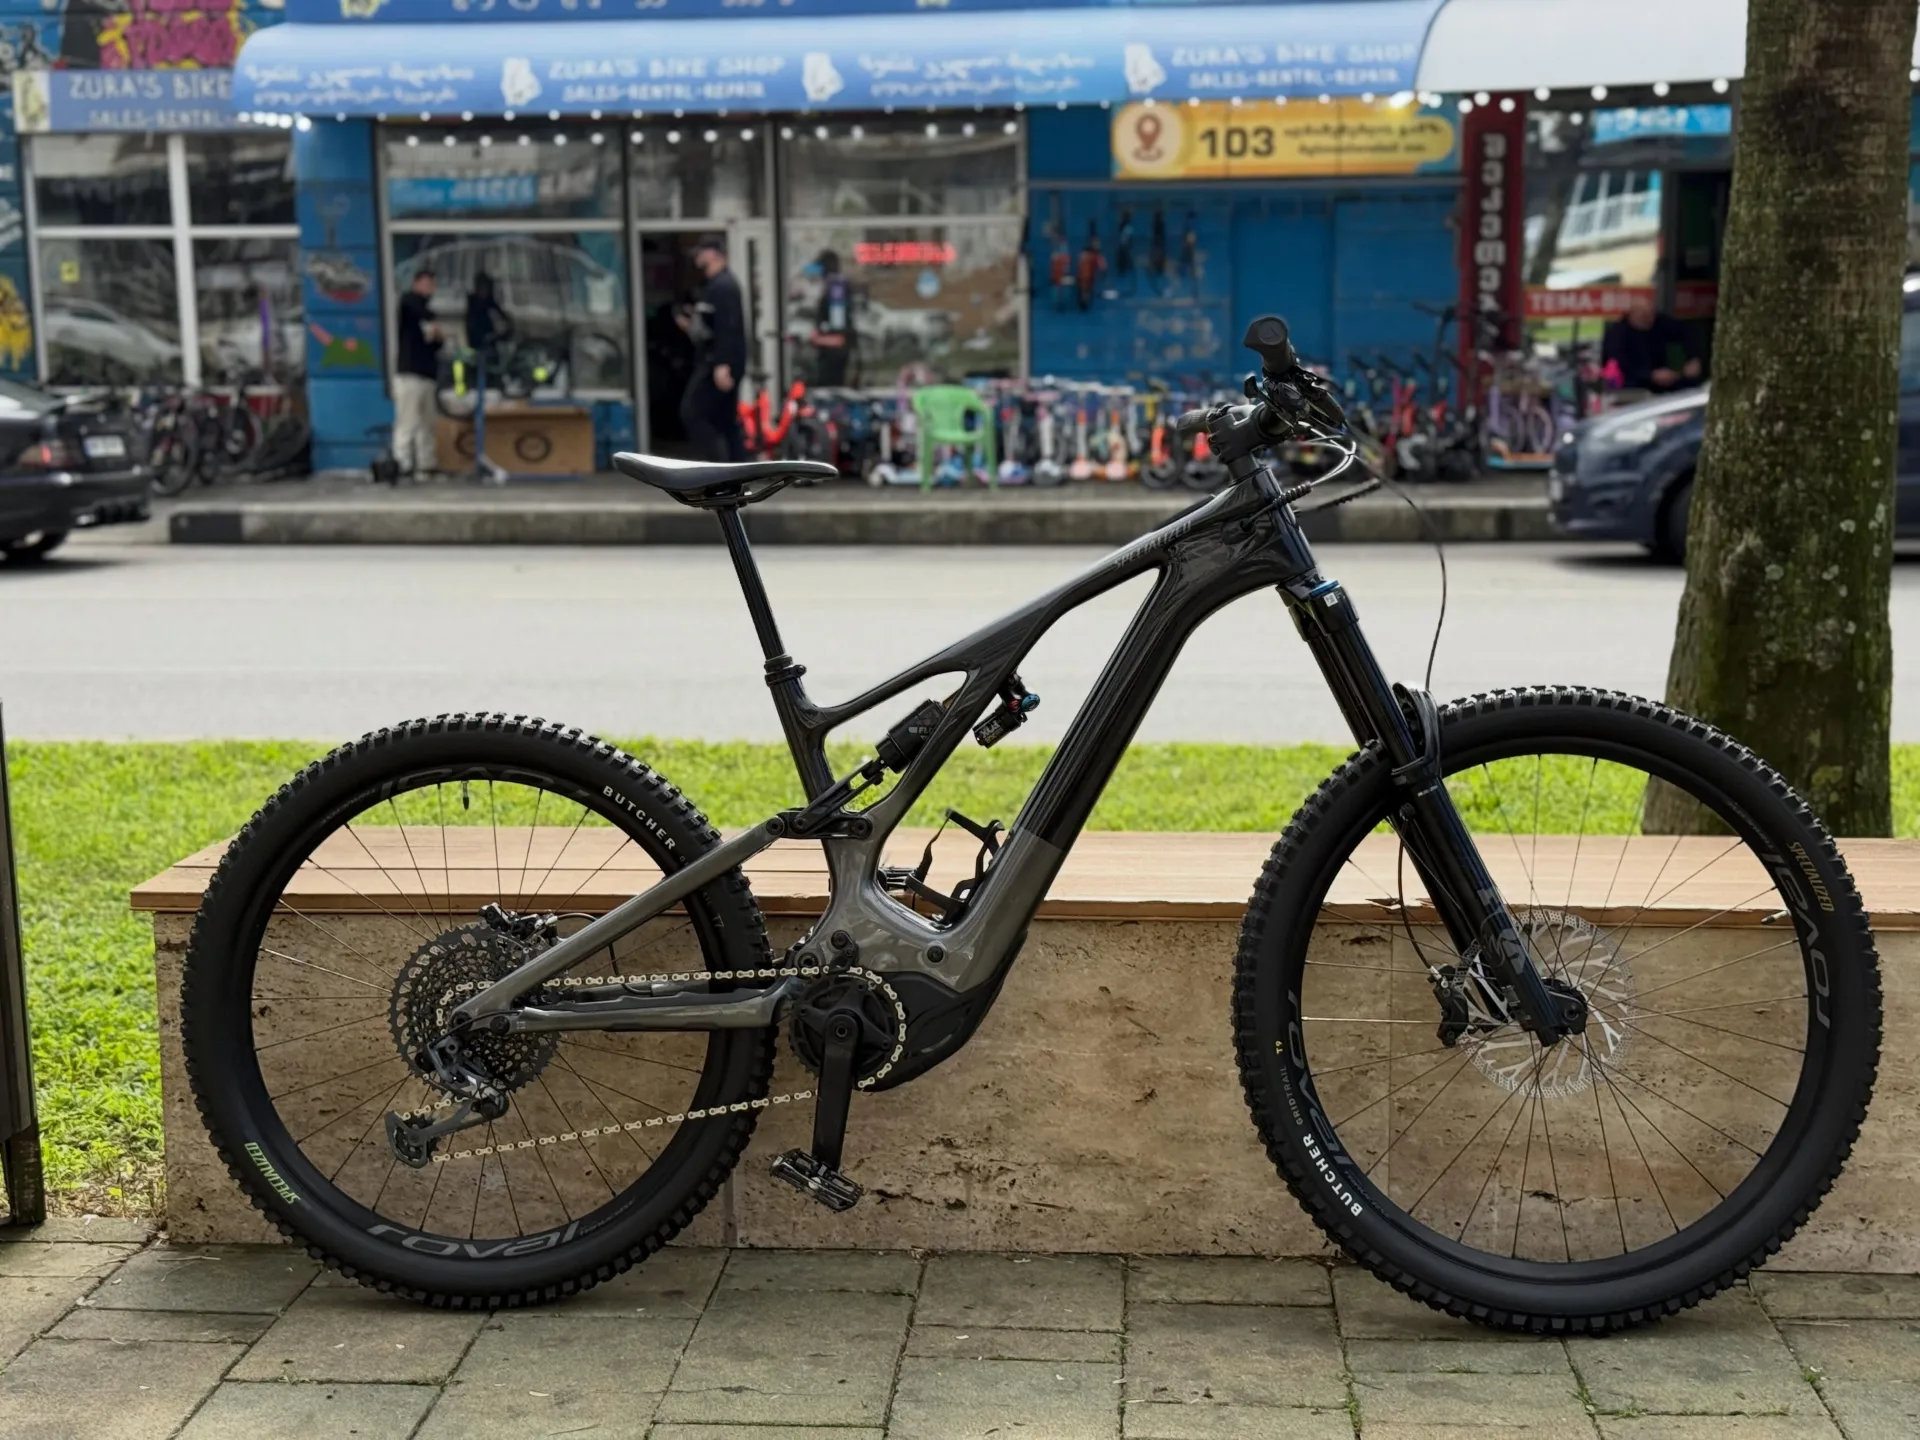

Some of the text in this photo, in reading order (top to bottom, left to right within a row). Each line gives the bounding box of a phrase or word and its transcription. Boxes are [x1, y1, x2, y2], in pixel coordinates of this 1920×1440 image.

[549, 56, 786, 79] ZURA'S BIKE SHOP
[1171, 43, 1415, 67] ZURA'S BIKE SHOP
[69, 74, 163, 100] ZURA'S
[172, 72, 232, 99] BIKE
[1199, 126, 1275, 157] 103
[1114, 520, 1192, 568] SPECIALIZED
[602, 785, 677, 850] BUTCHER
[1785, 841, 1836, 913] SPECIALIZED
[1760, 852, 1831, 1030] roval
[1275, 1039, 1284, 1055] T9
[1287, 988, 1354, 1166] roval
[244, 1142, 301, 1205] SPECIALIZED
[1302, 1132, 1363, 1217] BUTCHER
[367, 1220, 580, 1259] roval
